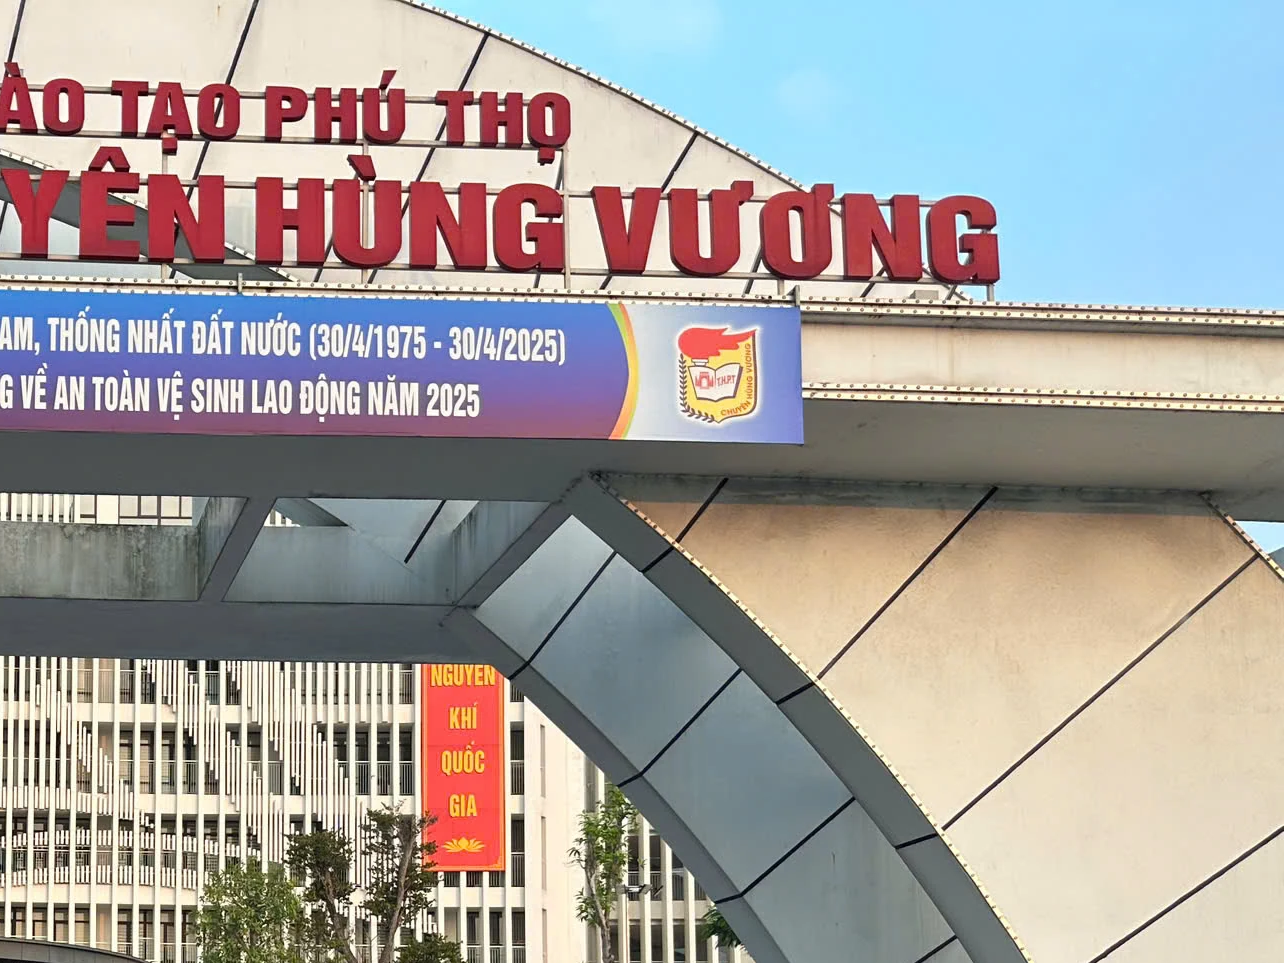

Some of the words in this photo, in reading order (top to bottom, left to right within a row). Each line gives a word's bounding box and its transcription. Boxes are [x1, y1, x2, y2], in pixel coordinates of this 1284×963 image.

[111, 81, 242, 155] TẠO
[265, 70, 407, 145] PHÚ
[436, 89, 571, 165] THỌ
[255, 154, 565, 274] HÙNG
[591, 180, 1000, 285] VƯƠNG
[47, 306, 121, 354] THỐNG
[127, 308, 187, 355] NHẤT
[191, 309, 235, 356] ĐẤT
[240, 312, 302, 357] NƯỚC
[309, 323, 427, 361] (30/4/1975
[433, 341, 443, 349] -
[448, 326, 567, 367] 30/4/2025)
[20, 362, 49, 410] VỀ
[53, 375, 86, 411] AN
[91, 369, 151, 412] TOÀN
[156, 370, 184, 421] VỆ
[190, 377, 245, 414] SINH
[251, 378, 293, 415] LAO
[298, 372, 361, 423] ĐỘNG
[367, 373, 420, 417] NĂM
[426, 382, 480, 418] 2025
[449, 702, 479, 729] KHÍ
[441, 740, 485, 776] QUỐC
[449, 794, 478, 818] GIA
